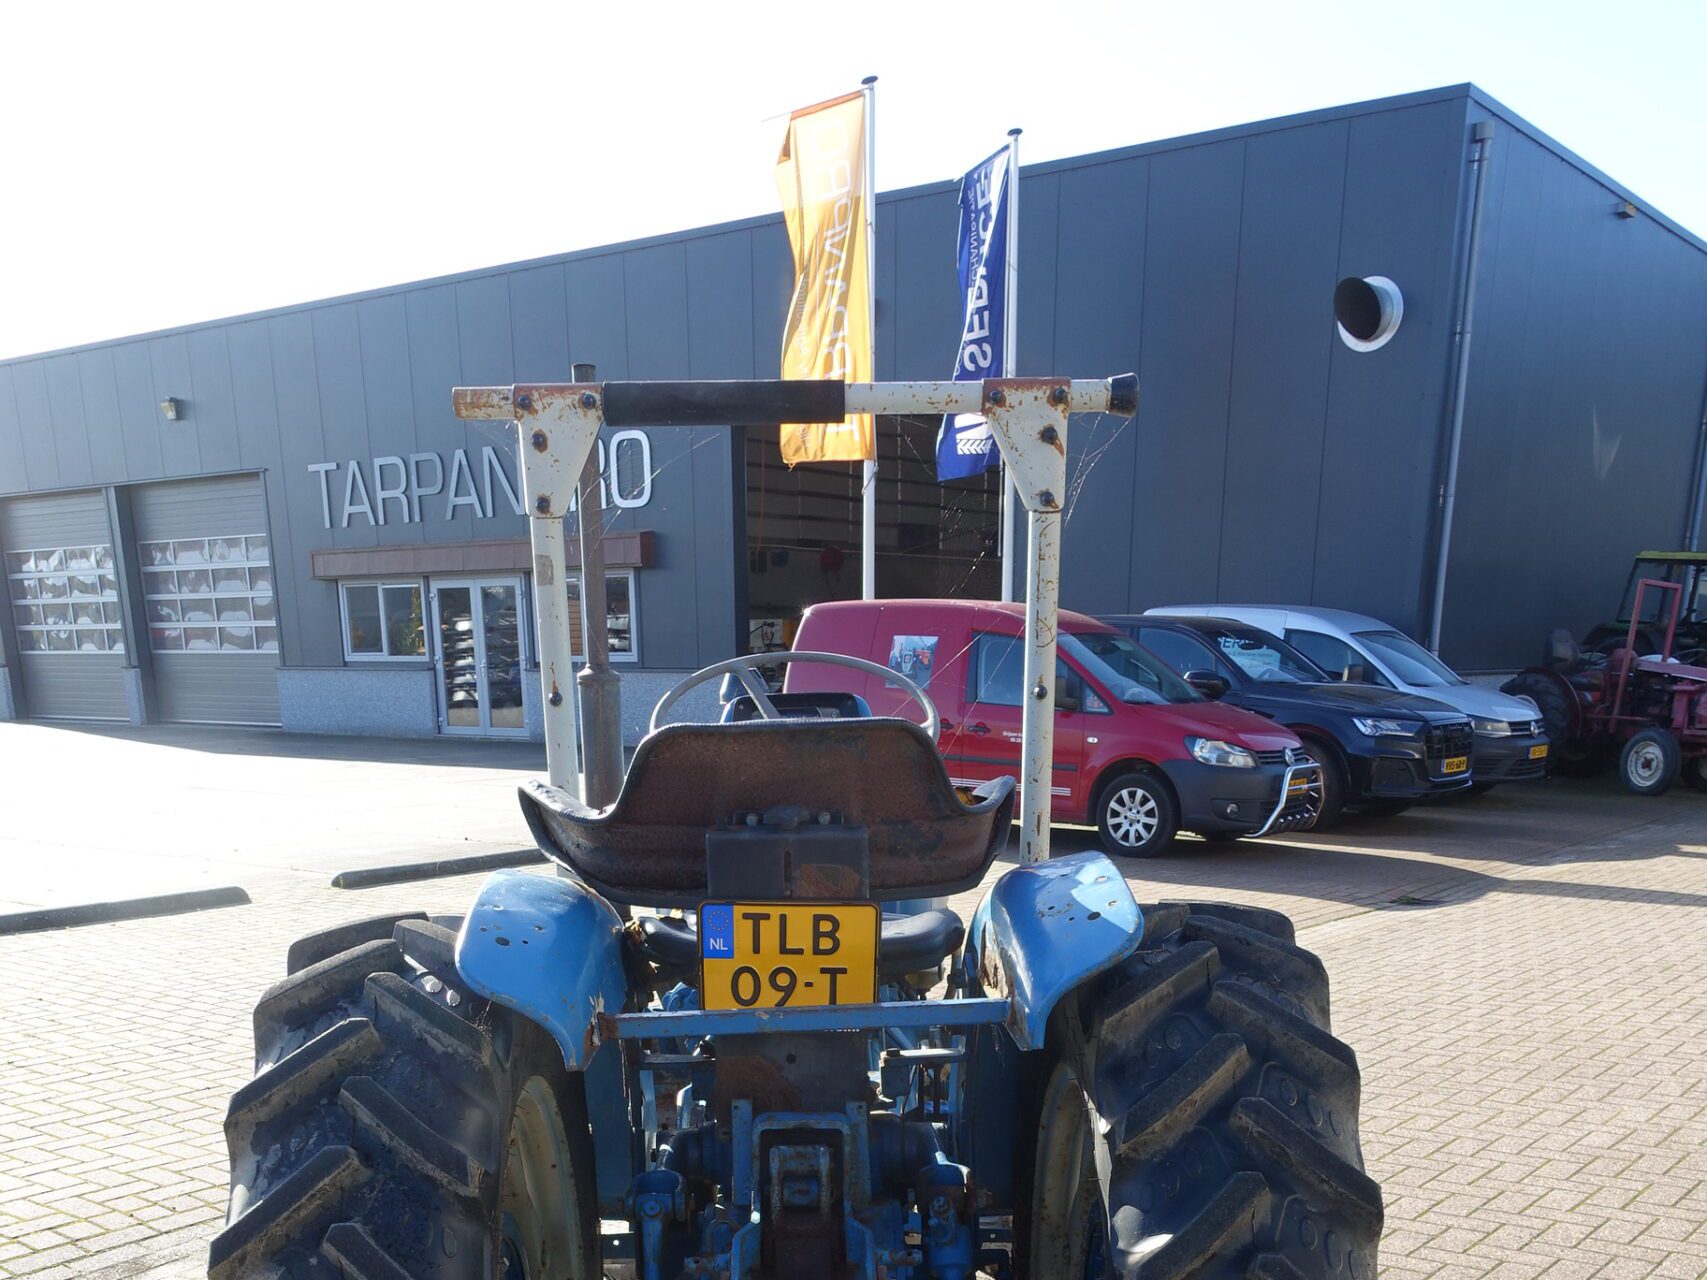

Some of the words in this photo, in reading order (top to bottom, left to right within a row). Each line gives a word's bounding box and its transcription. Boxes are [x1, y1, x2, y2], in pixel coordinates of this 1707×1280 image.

[307, 430, 652, 529] TARPANO
[709, 938, 729, 951] NL
[742, 912, 841, 956] TLB
[730, 965, 848, 1007] 09-T
